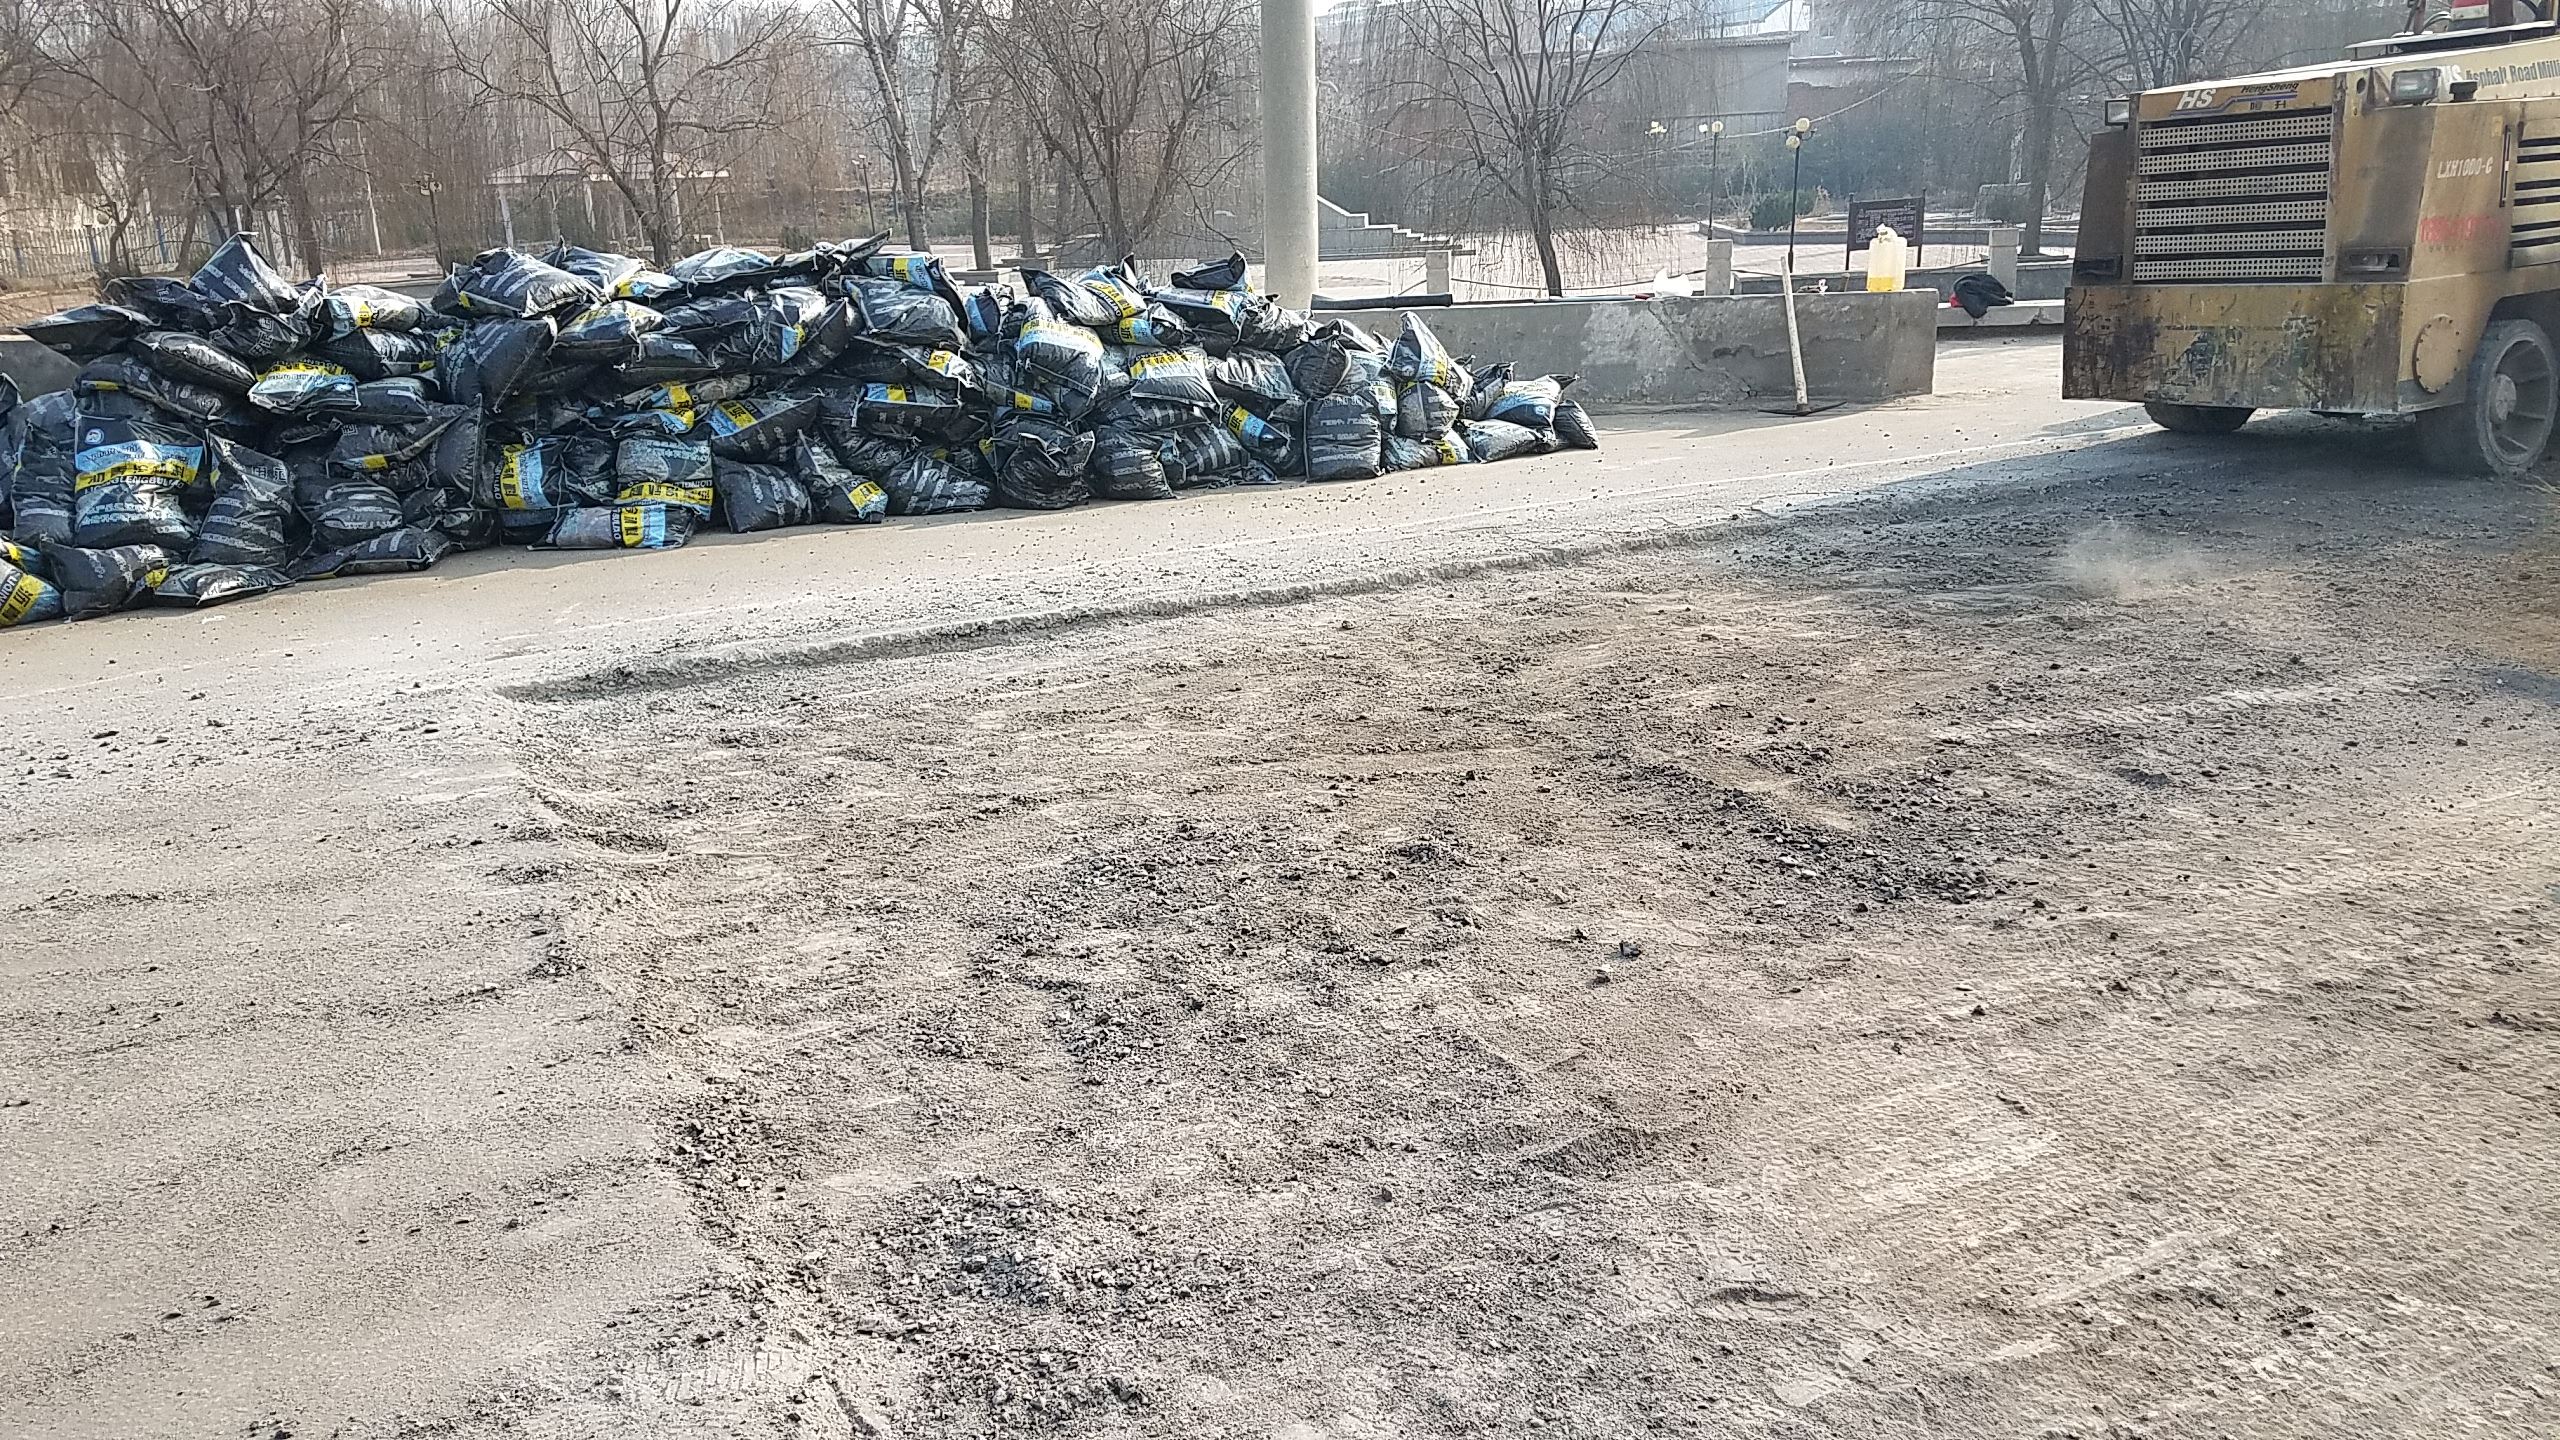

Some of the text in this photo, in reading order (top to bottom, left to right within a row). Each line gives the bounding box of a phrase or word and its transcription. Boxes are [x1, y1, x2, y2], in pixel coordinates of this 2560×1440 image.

[2509, 62, 2538, 83] Road
[2241, 81, 2300, 94] HengSheng
[2176, 88, 2216, 111] HS
